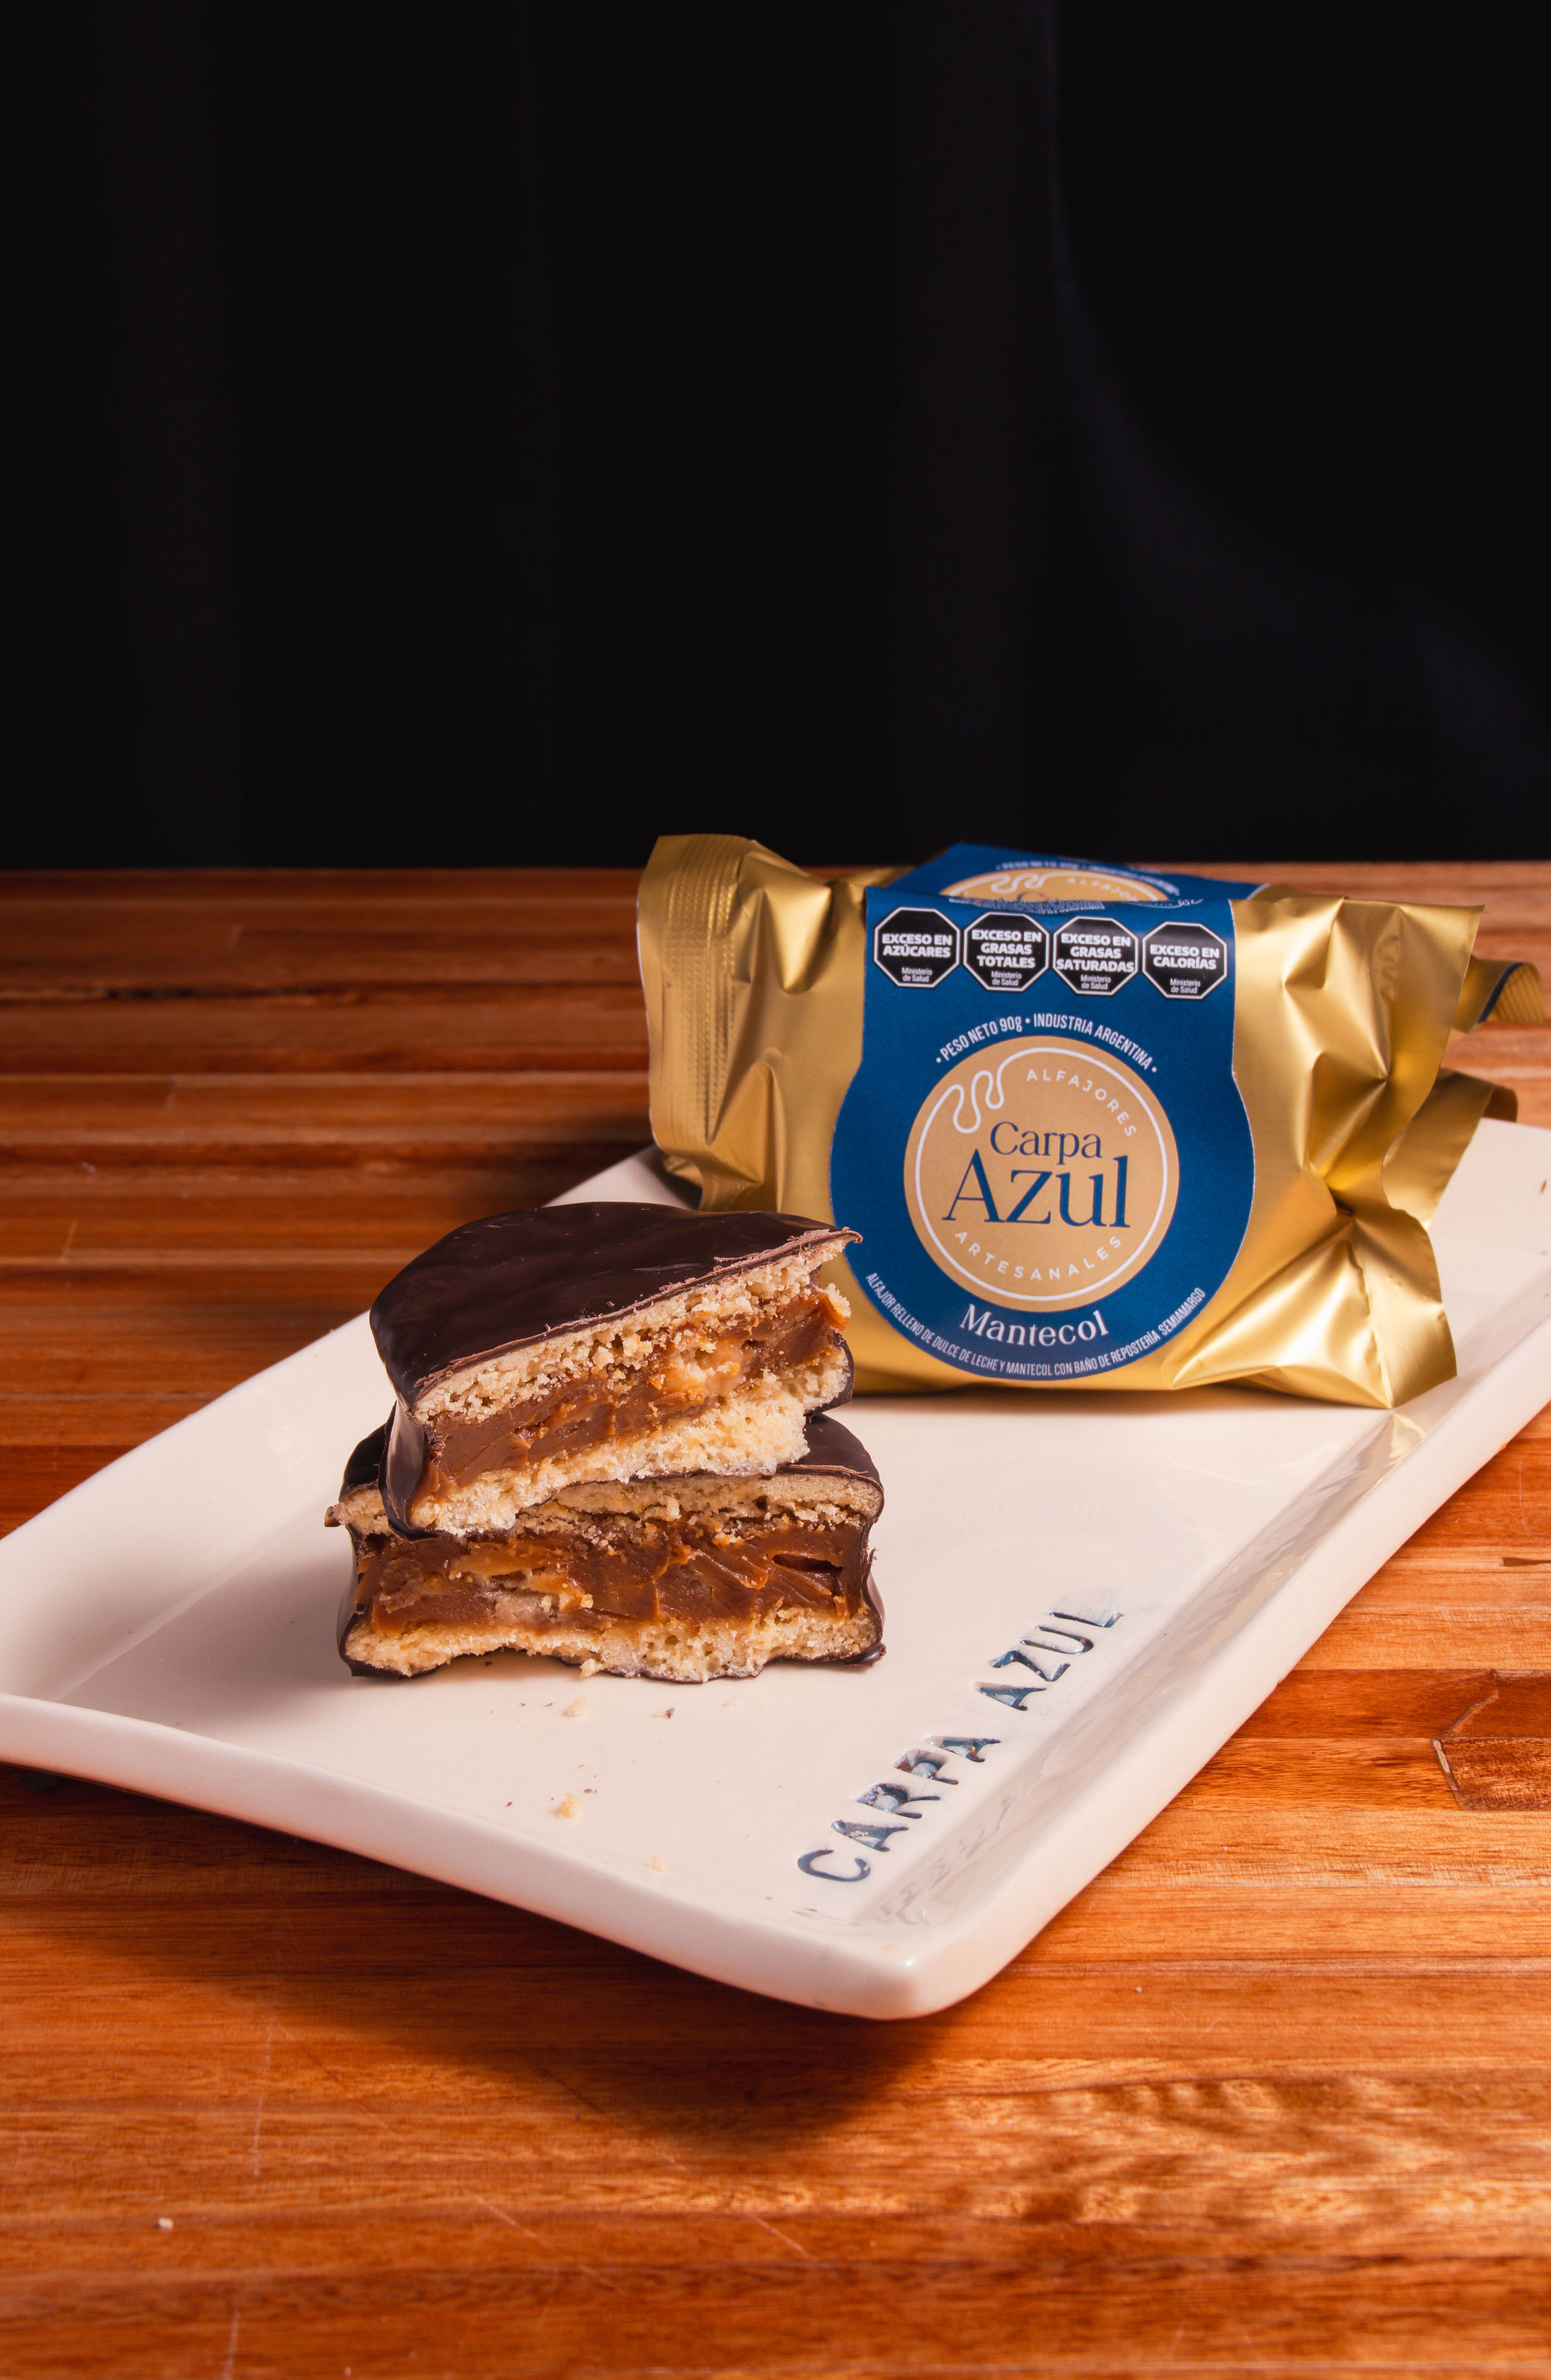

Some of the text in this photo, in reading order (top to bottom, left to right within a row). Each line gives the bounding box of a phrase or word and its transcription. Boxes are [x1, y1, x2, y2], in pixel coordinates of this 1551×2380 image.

[882, 933, 953, 946] EXCESO EN
[972, 929, 1042, 943] EXCESO EN
[1061, 933, 1131, 947] EXCESO EN
[883, 944, 951, 958] AZÚCARES
[980, 943, 1032, 955] GRASAS
[1070, 946, 1122, 959] GRASAS
[1150, 944, 1220, 958] EXCESO EN
[977, 955, 1035, 968] TOTALES
[1056, 959, 1135, 973] SATURADAS
[1153, 956, 1217, 970] CALORÍAS
[901, 967, 932, 976] Ministerio
[912, 974, 929, 982] Salud
[991, 971, 1022, 979] Ministerio
[1081, 974, 1111, 983] Ministerio
[1001, 978, 1019, 986] Salud
[1091, 982, 1108, 990] Salud
[1170, 978, 1200, 987] Ministerio
[1180, 985, 1198, 994] Salud
[940, 1013, 1153, 1070] PESO NETO 90g INDUSTRIA ARGENTINA
[1026, 1068, 1137, 1138] ALFAJORES
[990, 1120, 1103, 1166] Carpa
[941, 1148, 1131, 1228] Azul
[955, 1230, 1122, 1281] ARTESANALES
[866, 1273, 1206, 1376] ALFAJOR RELLENO DE DULCE DE LECHE Y MANTECOL CON BAÑO DE REPOSTERÍA SEMIAMARGO
[959, 1303, 1109, 1347] Mantecol
[797, 1610, 1125, 1882] CARPA AZUL
